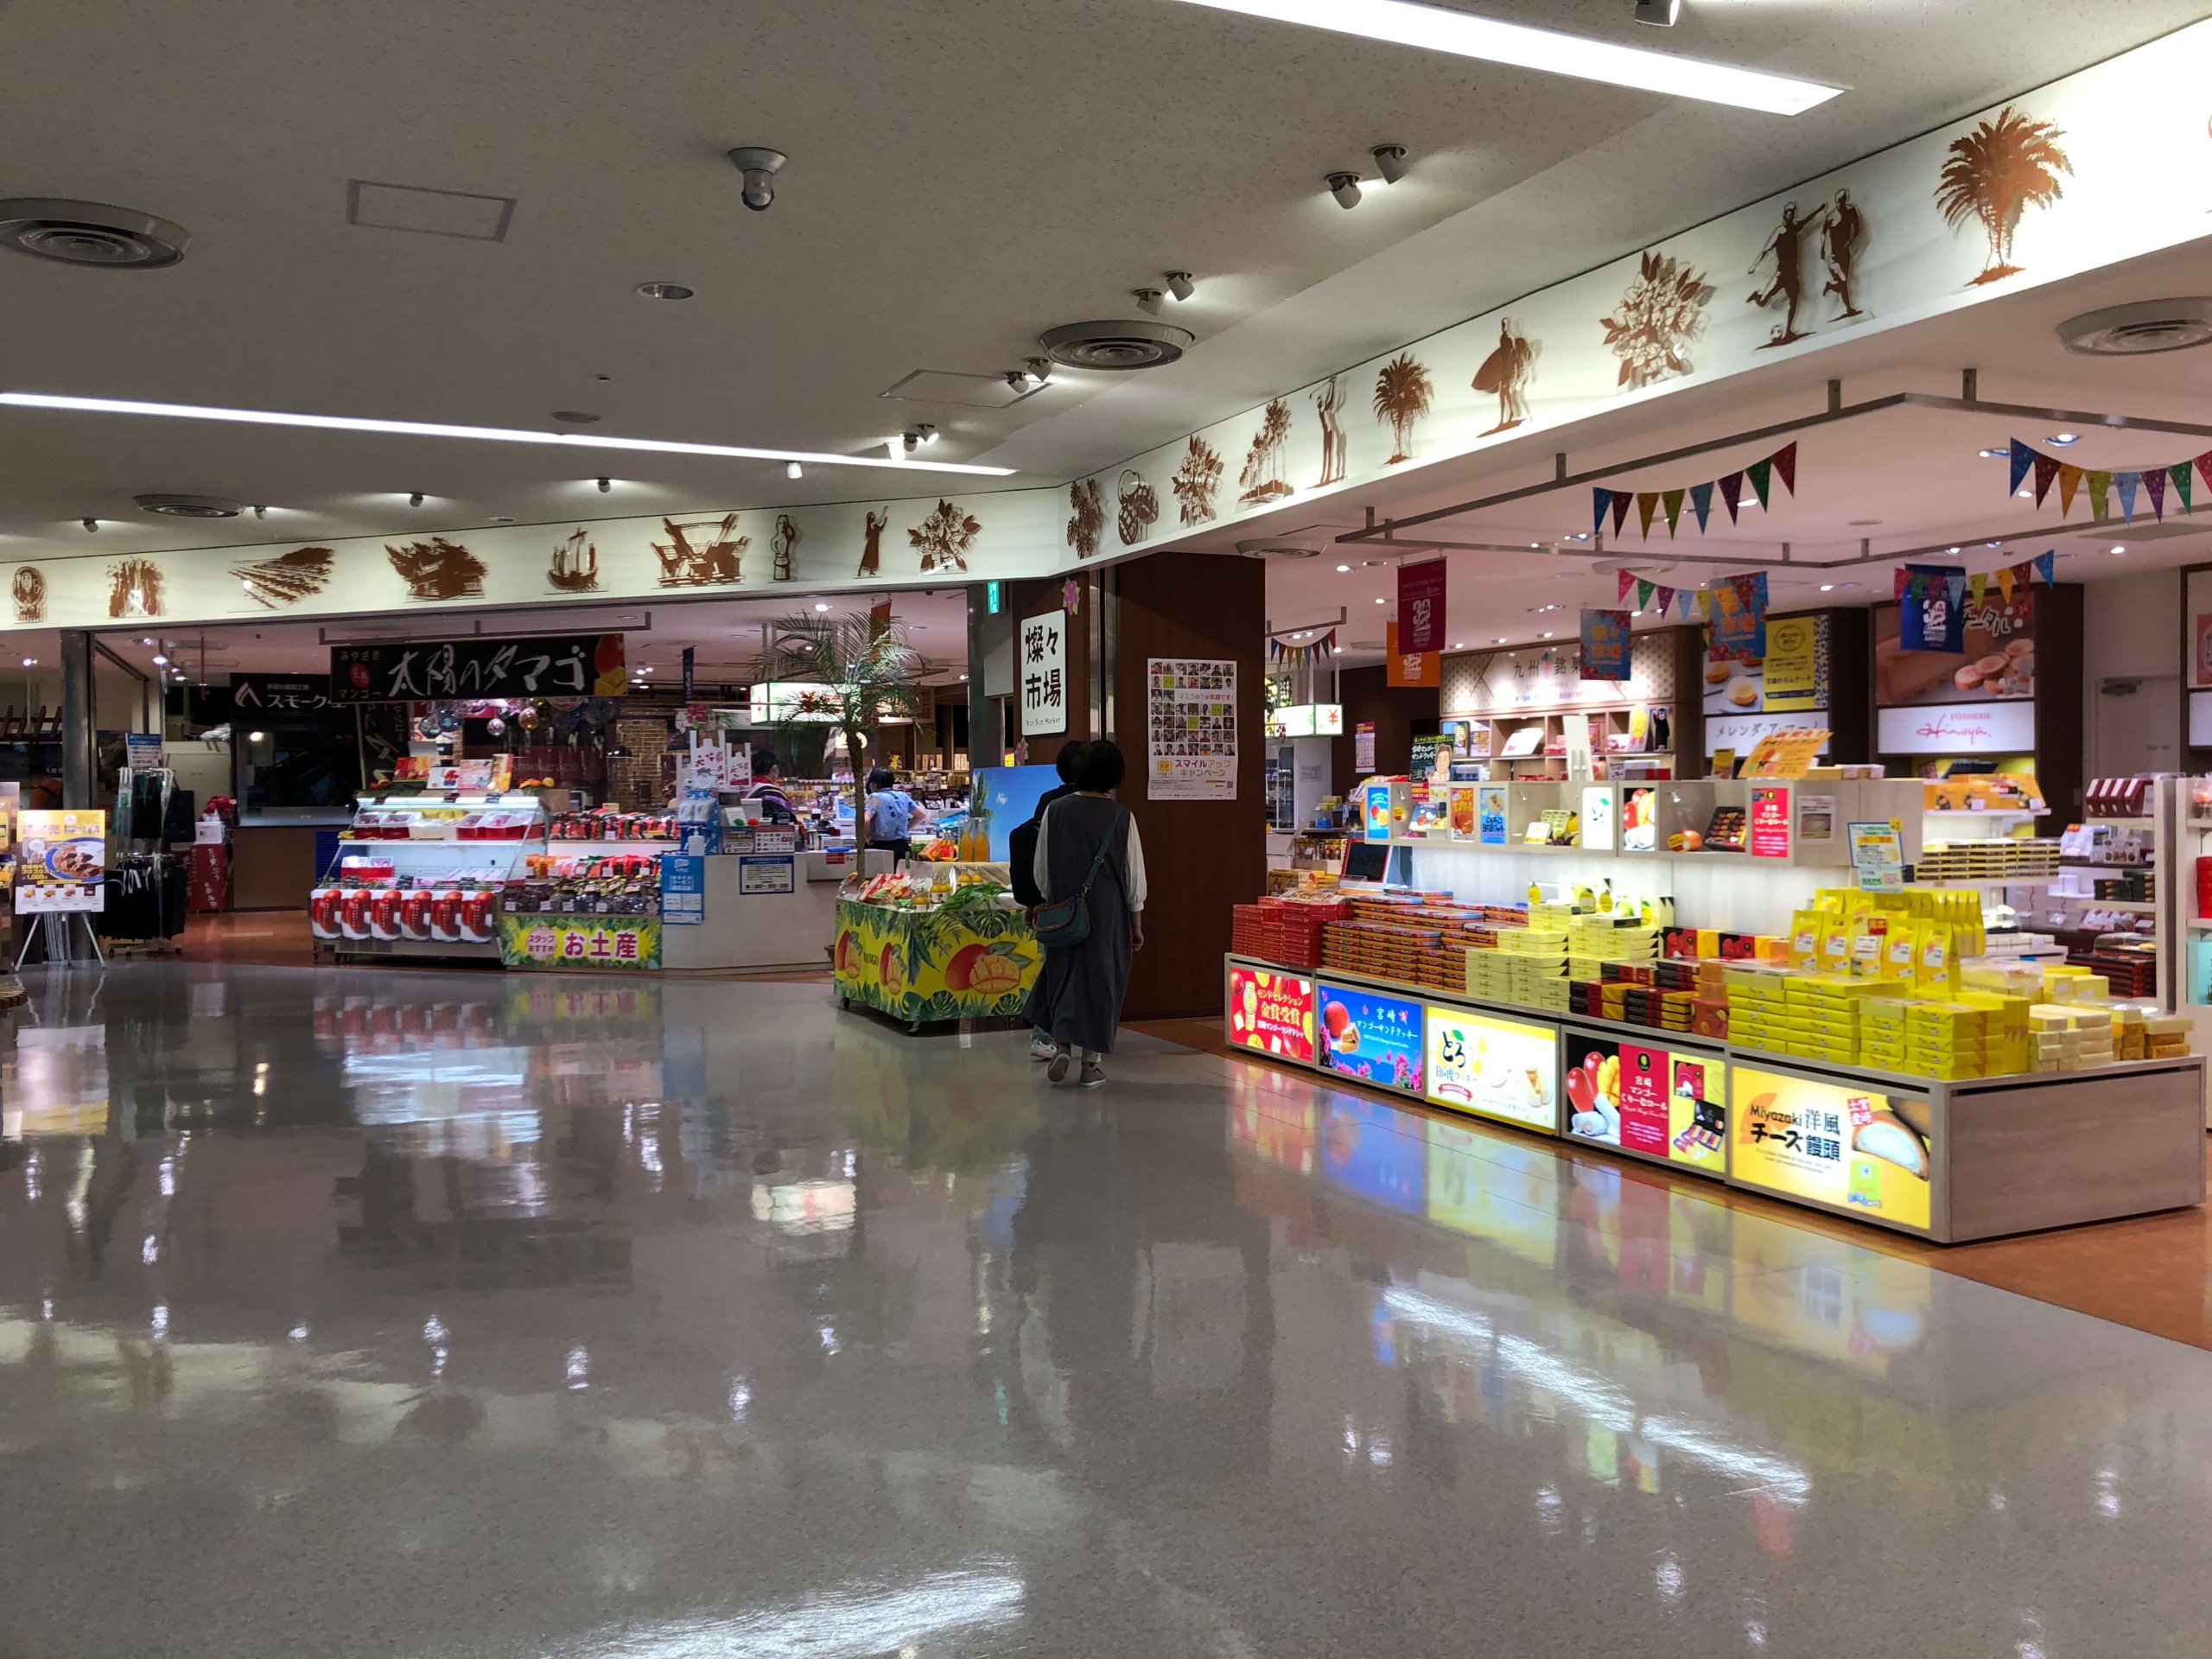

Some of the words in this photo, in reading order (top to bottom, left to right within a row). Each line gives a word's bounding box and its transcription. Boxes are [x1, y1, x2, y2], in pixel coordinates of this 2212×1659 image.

[1025, 624, 1059, 664] 燦々
[1514, 659, 1540, 679] 九州
[1025, 668, 1061, 710] 市場
[1175, 759, 1231, 768] スマイルアップ
[1180, 768, 1226, 778] キャンペーン
[564, 931, 638, 959] お土産
[1256, 988, 1304, 1007] モンドセレクション
[1261, 1001, 1301, 1027] 金賞受賞
[1376, 1007, 1396, 1023] 宮崎
[1357, 1020, 1419, 1039] マンゴーサンドクッキー
[1442, 1031, 1466, 1068] とろ
[1629, 1085, 1659, 1097] マンゴー
[1634, 1075, 1653, 1088] 宮崎
[1750, 1104, 1803, 1128] Miyazaki
[1805, 1109, 1841, 1136] 洋風
